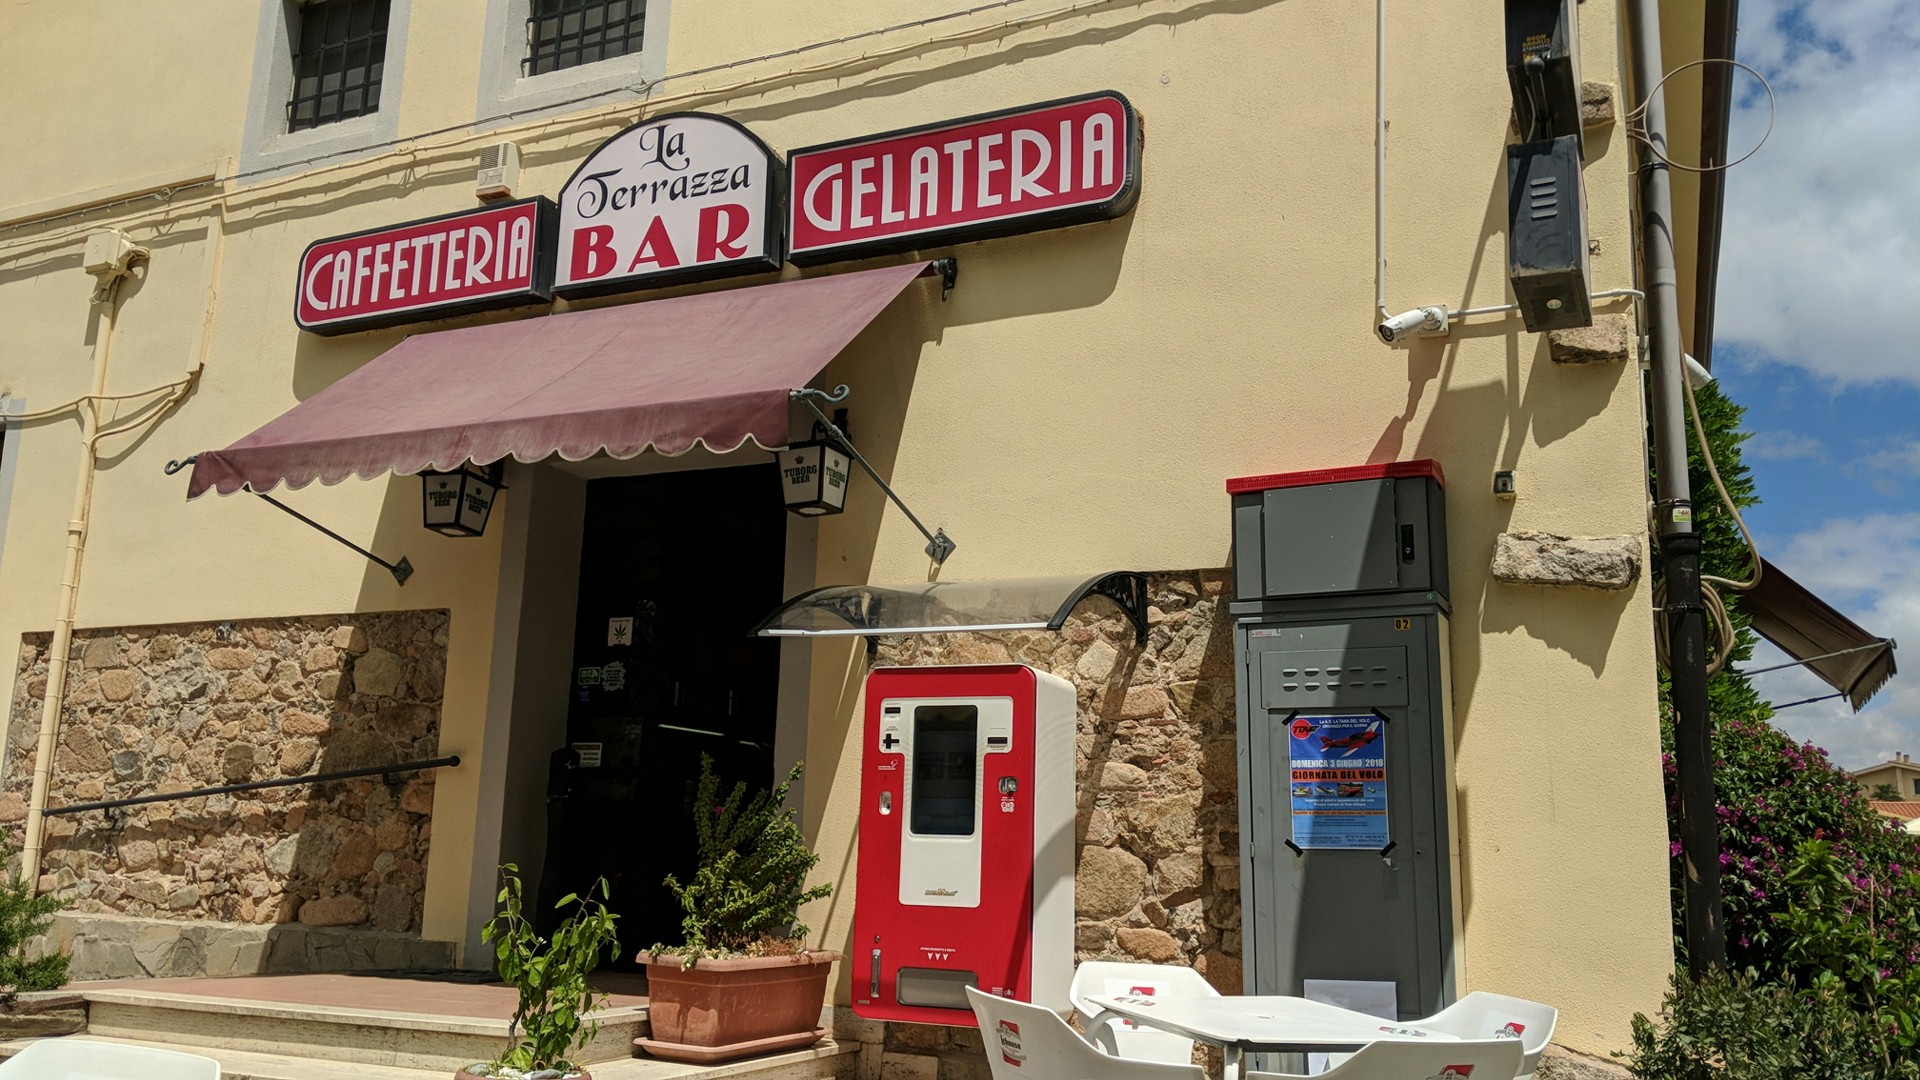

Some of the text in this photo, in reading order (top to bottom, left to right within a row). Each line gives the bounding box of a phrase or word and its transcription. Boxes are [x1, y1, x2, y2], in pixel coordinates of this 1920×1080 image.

[639, 124, 690, 171] La
[803, 112, 1114, 231] GELATERIA
[576, 164, 751, 218] Terrazza
[569, 203, 750, 281] BAR
[305, 216, 531, 311] CAFFETTERIA
[784, 465, 817, 478] TUBORG
[826, 466, 846, 483] TUBORG
[791, 475, 811, 485] BEER
[829, 478, 841, 489] BEER
[428, 490, 458, 500] TUBORG
[434, 498, 451, 507] BEER
[465, 493, 489, 510] TUBORG
[468, 503, 482, 514] BEER
[1396, 619, 1409, 629] 02
[1291, 760, 1328, 768] DOMENICA
[1336, 759, 1362, 767] GIUGNO
[1365, 759, 1384, 767] 2018
[1292, 770, 1384, 779] GIORNATA DEL VOLO
